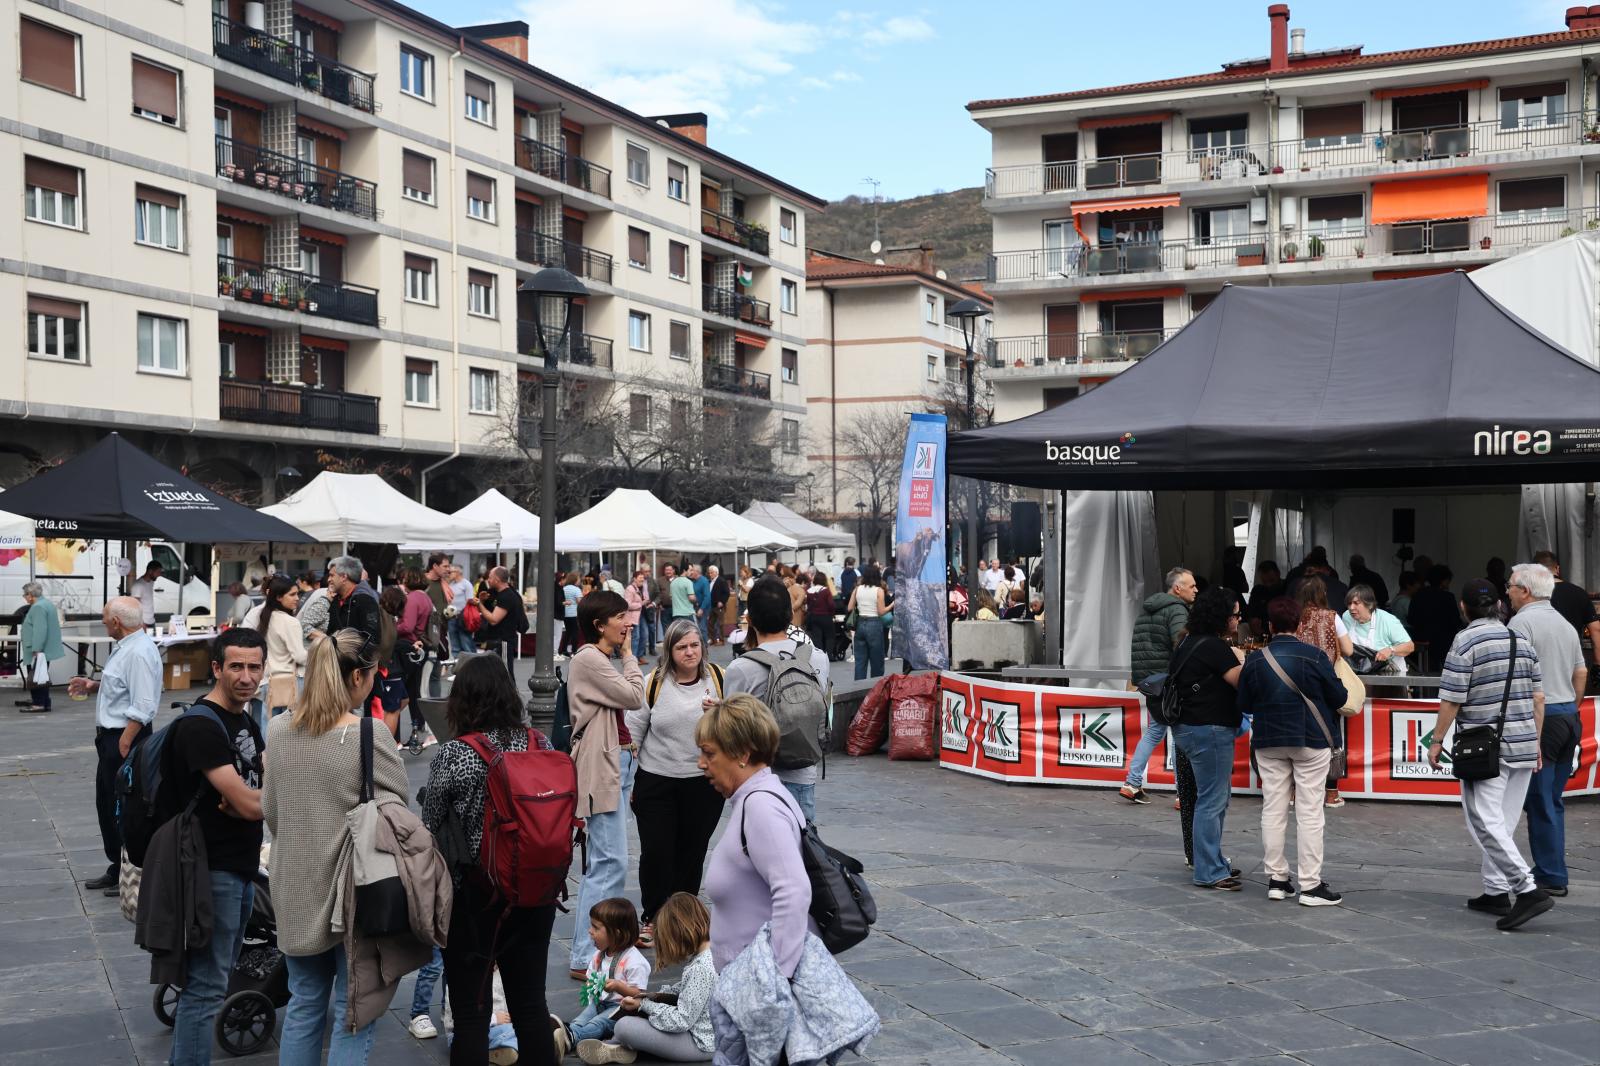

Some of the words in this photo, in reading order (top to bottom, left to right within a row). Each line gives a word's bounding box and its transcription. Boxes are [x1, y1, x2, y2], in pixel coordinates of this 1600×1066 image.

[1474, 425, 1552, 456] nirea
[1045, 440, 1121, 466] basque
[144, 490, 209, 502] iztueta
[1063, 752, 1092, 761] EUSKO
[1095, 754, 1121, 763] LABEL
[1395, 765, 1428, 774] EUSKO
